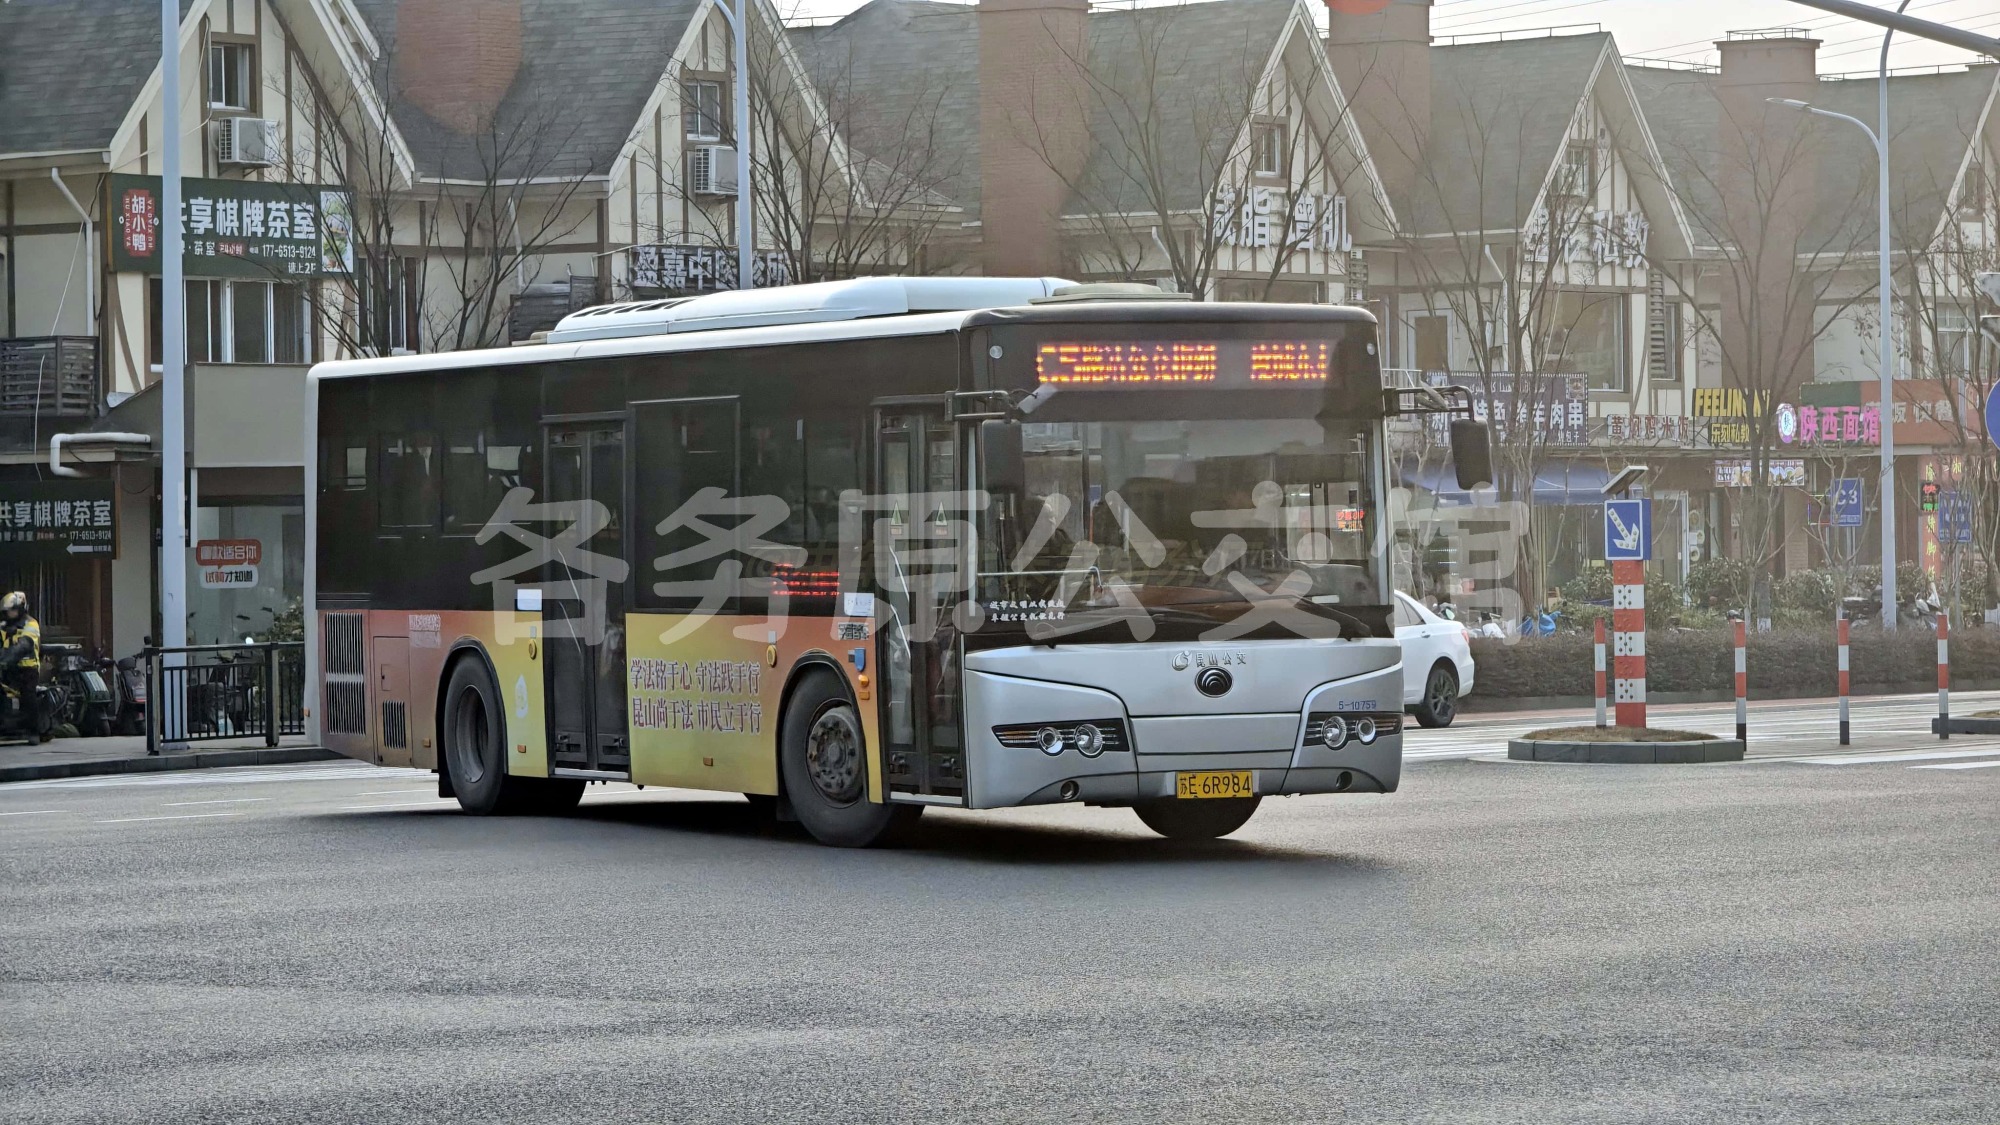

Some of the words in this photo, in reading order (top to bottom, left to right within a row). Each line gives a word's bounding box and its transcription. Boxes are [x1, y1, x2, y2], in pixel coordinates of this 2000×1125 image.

[131, 195, 147, 251] 胡小鸭
[262, 245, 316, 259] 177-6513-9124
[1431, 399, 1584, 431] 新特色烤羊肉串
[1800, 404, 1881, 446] 陕西面馆
[1711, 422, 1760, 444] 乐刻私教
[0, 500, 112, 527] 共享棋牌茶室
[1195, 651, 1247, 667] 昆山公交
[695, 660, 760, 694] 守法践于行
[632, 696, 694, 731] 昆山尚于法
[696, 700, 762, 734] 市民立于行
[1338, 700, 1377, 711] 5-10759
